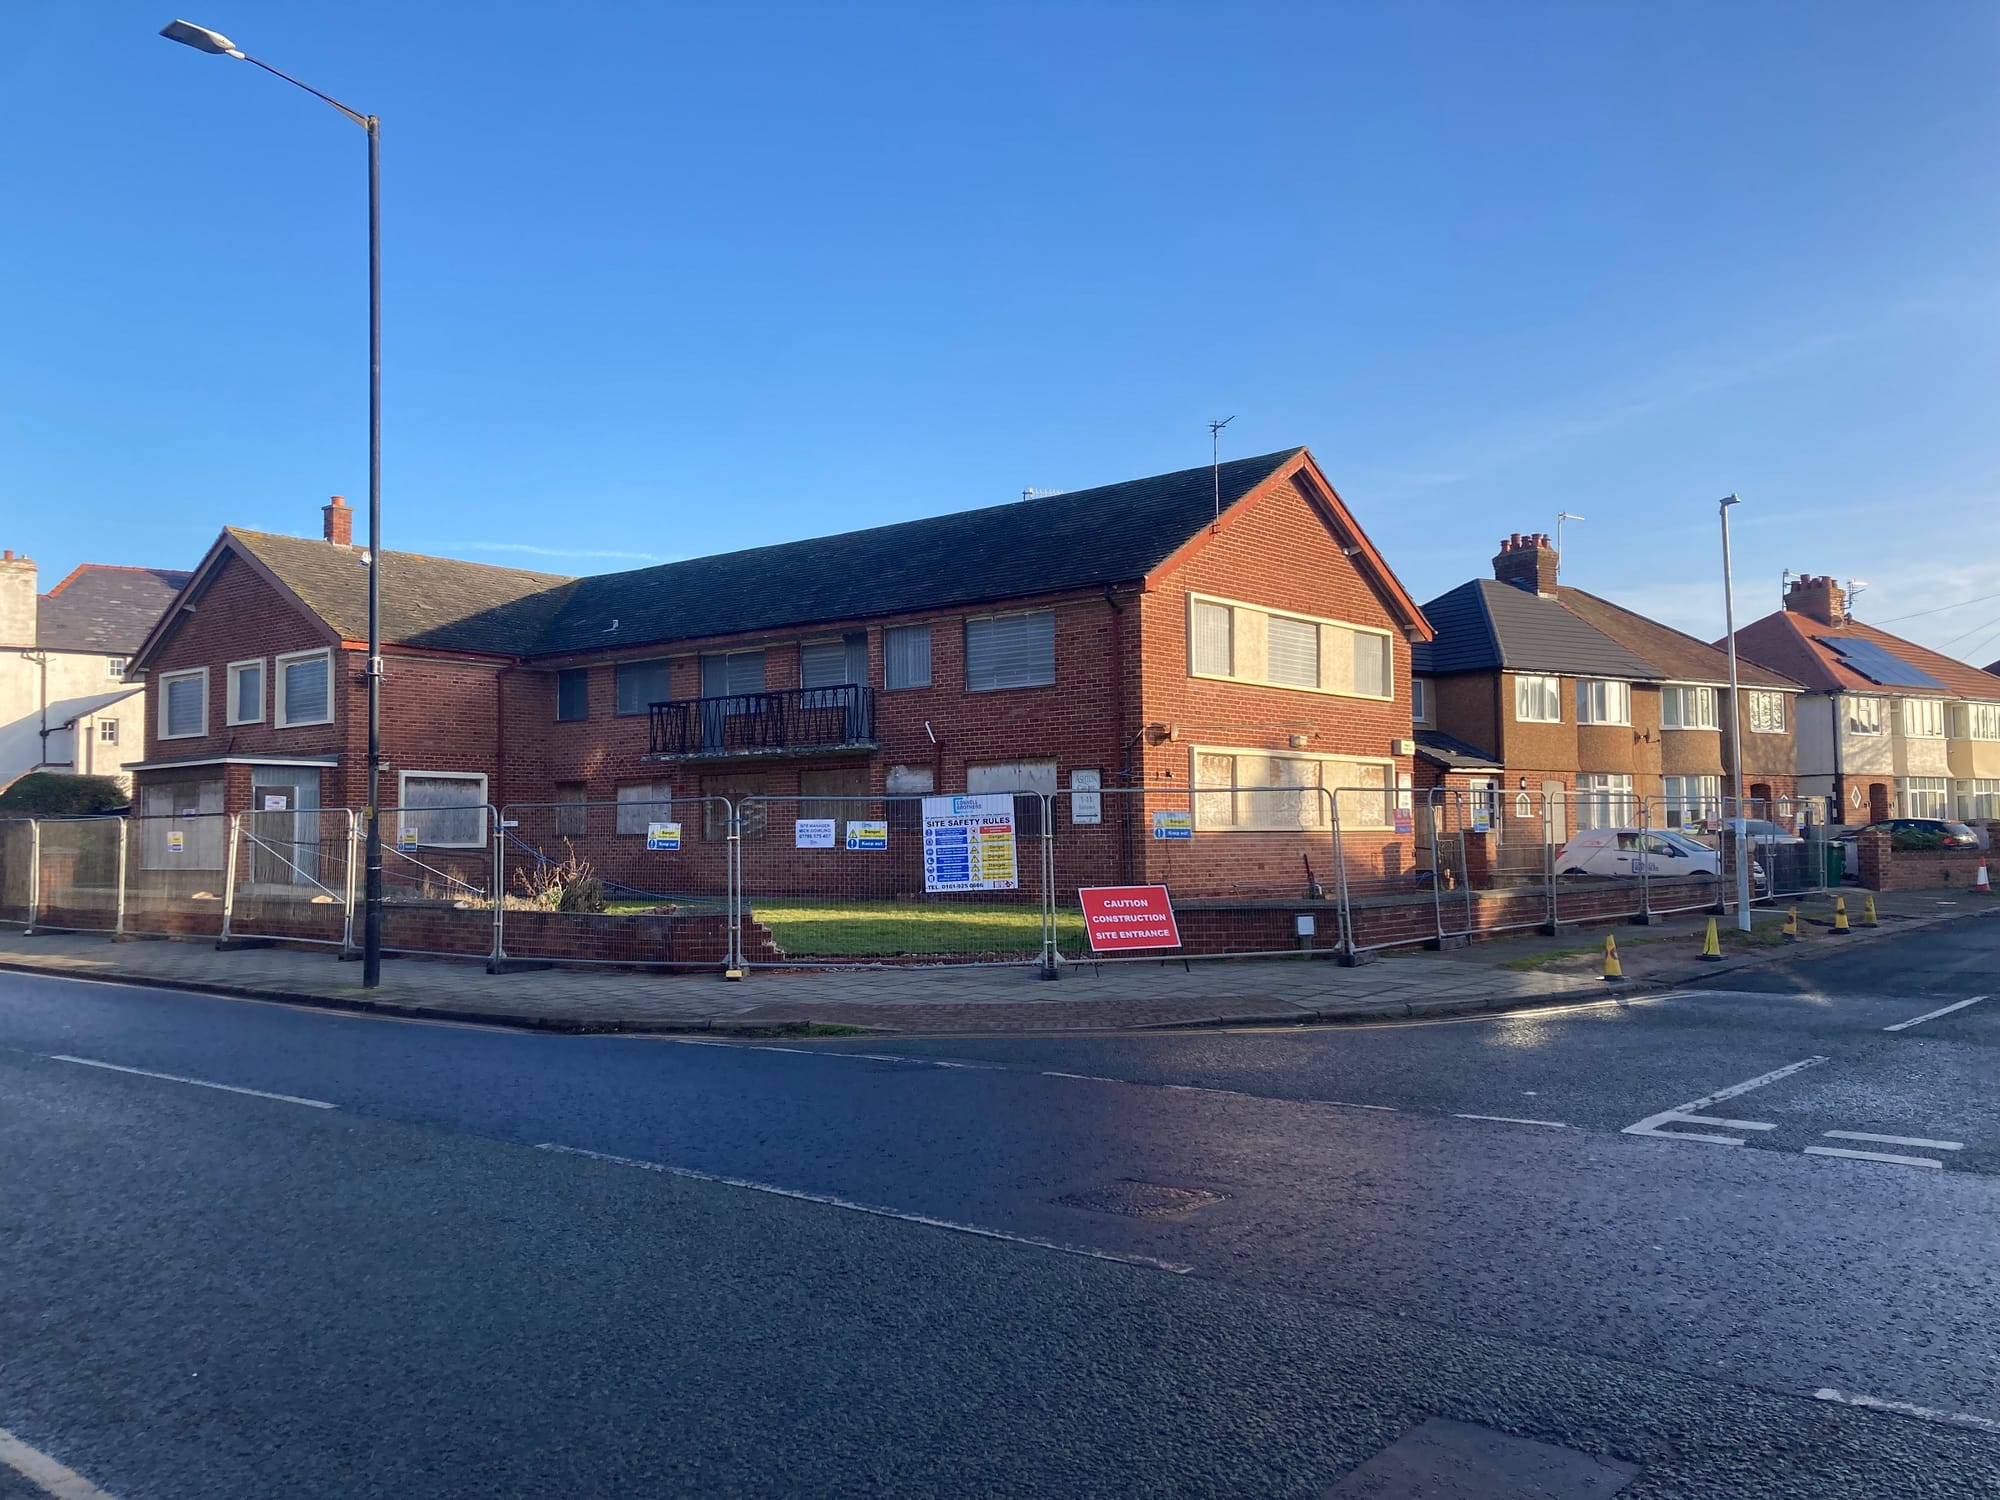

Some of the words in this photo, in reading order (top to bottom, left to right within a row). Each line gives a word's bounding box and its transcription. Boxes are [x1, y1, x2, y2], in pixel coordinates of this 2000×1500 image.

[926, 820, 946, 828] SITE
[948, 818, 980, 827] SAFETY
[982, 816, 1011, 825] RULES
[1103, 899, 1149, 908] CAUTION
[1092, 913, 1167, 923] CONSTRUCTION
[1095, 931, 1118, 940] SITE
[1119, 929, 1171, 939] ENTRANCE
